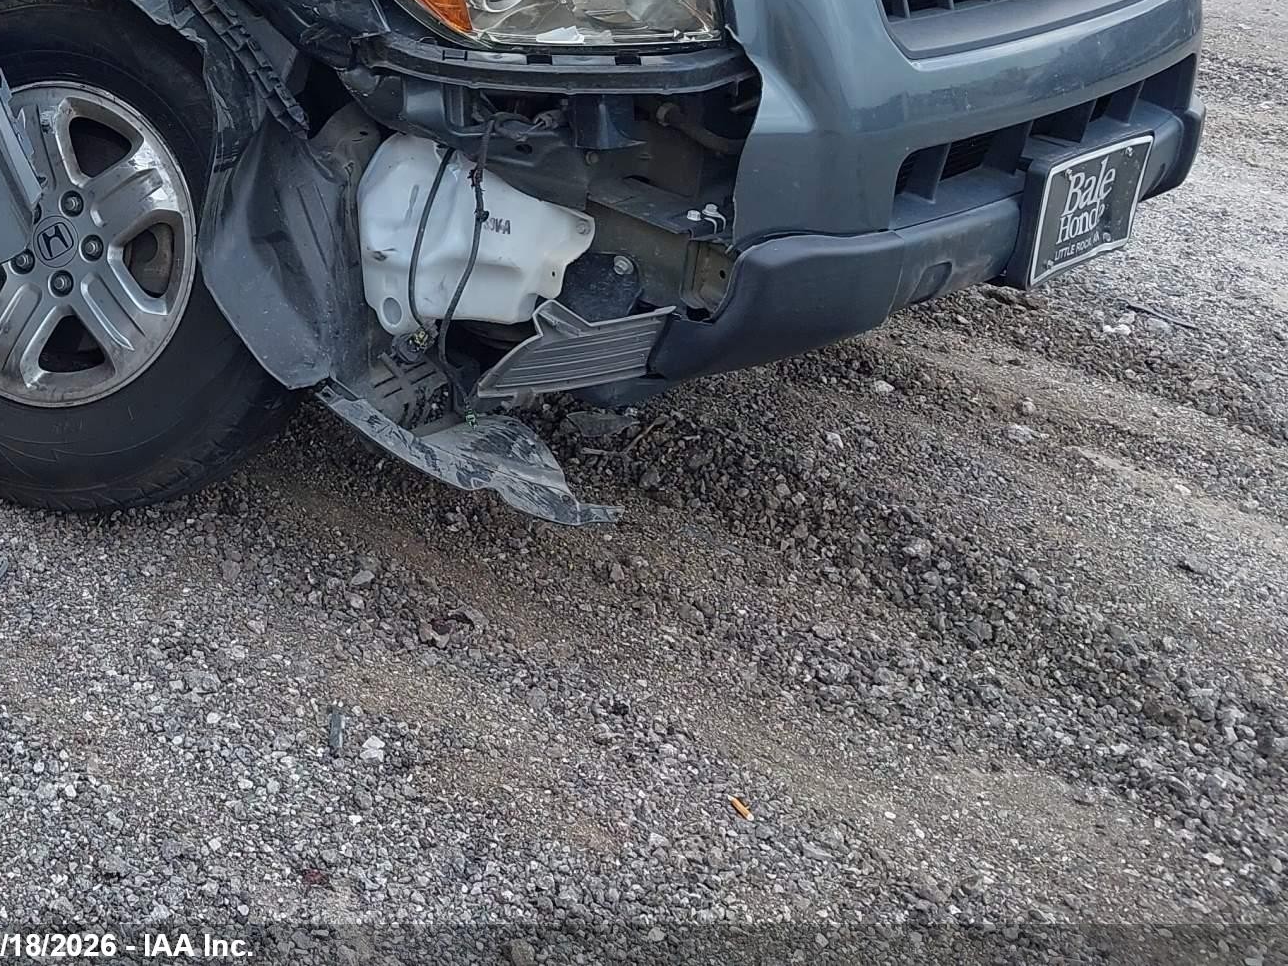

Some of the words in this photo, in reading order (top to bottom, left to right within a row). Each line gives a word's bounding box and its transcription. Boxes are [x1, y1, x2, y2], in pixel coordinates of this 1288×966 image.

[1063, 155, 1116, 215] Bale
[1055, 203, 1105, 245] Honda
[1054, 243, 1076, 261] LITTLE
